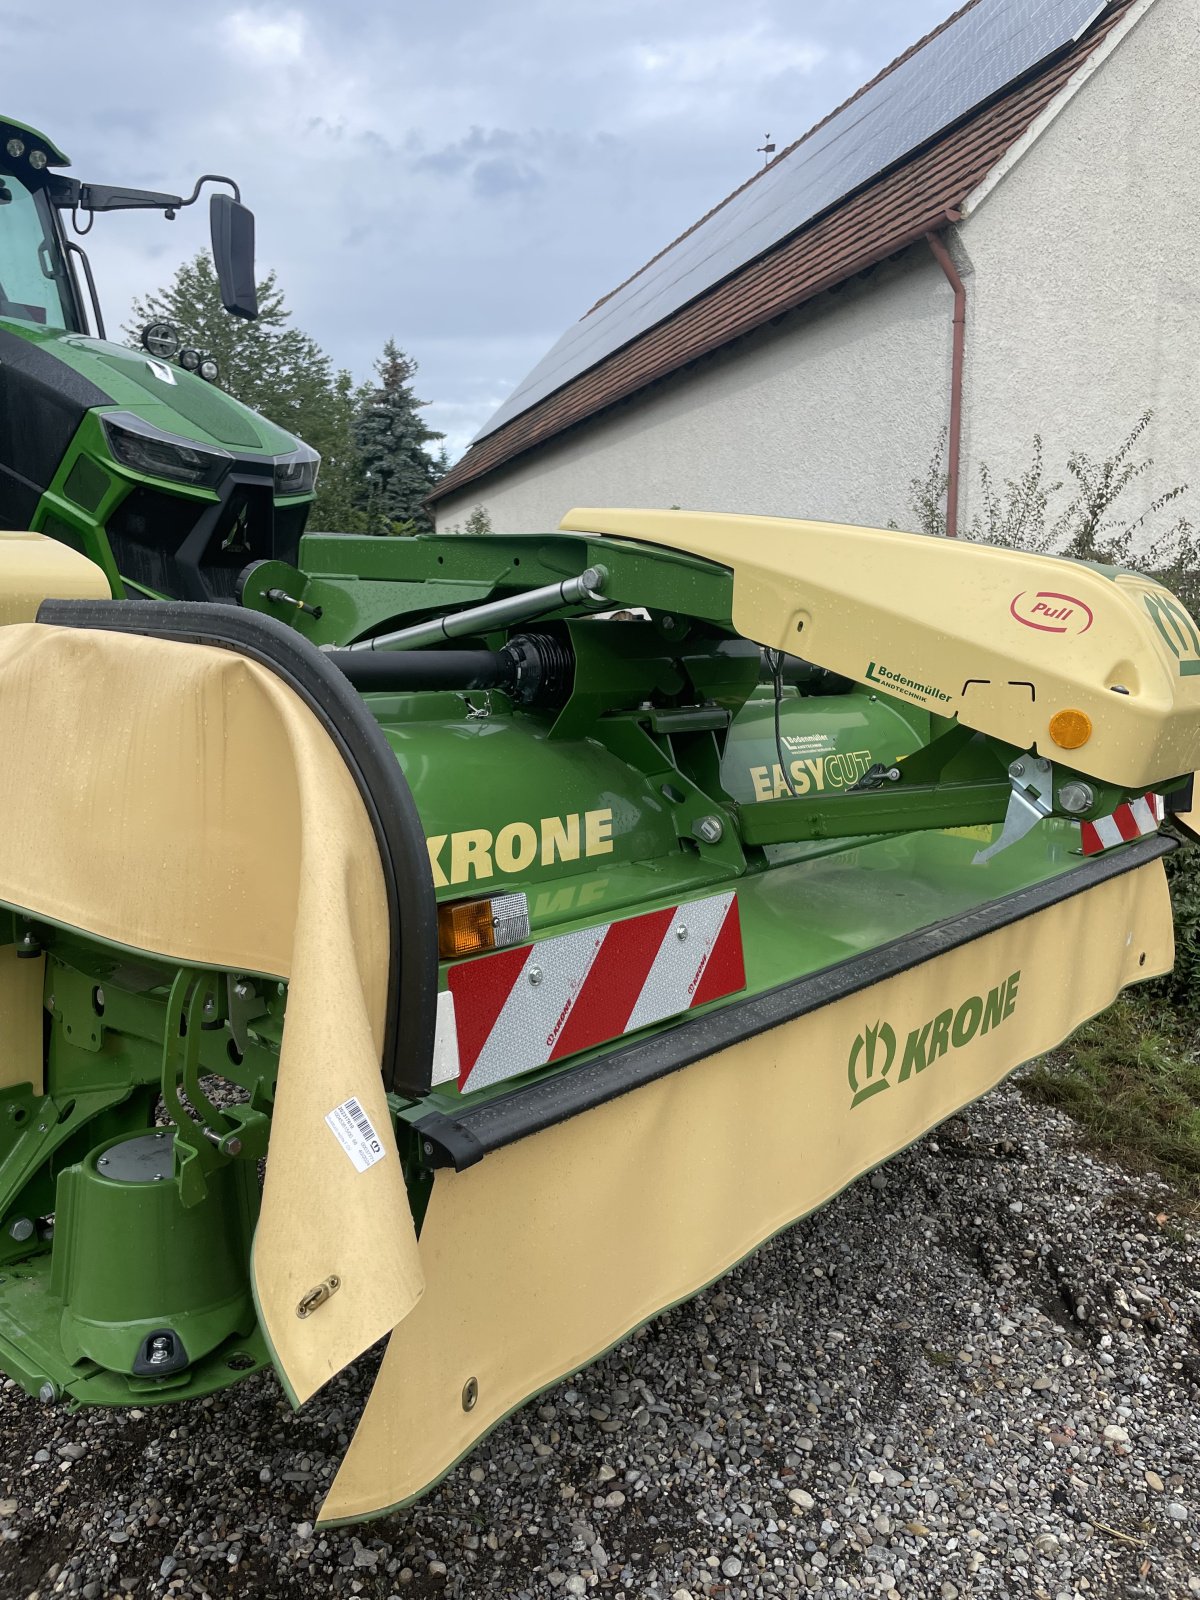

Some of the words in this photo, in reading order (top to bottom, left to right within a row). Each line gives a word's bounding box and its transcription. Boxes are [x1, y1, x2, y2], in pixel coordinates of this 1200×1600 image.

[1031, 601, 1075, 622] Pull
[878, 666, 953, 703] Bodenmüller
[749, 750, 872, 802] EASYCUT
[692, 953, 709, 987] KRONE
[551, 998, 574, 1037] KRONE
[898, 969, 1021, 1084] KRONE
